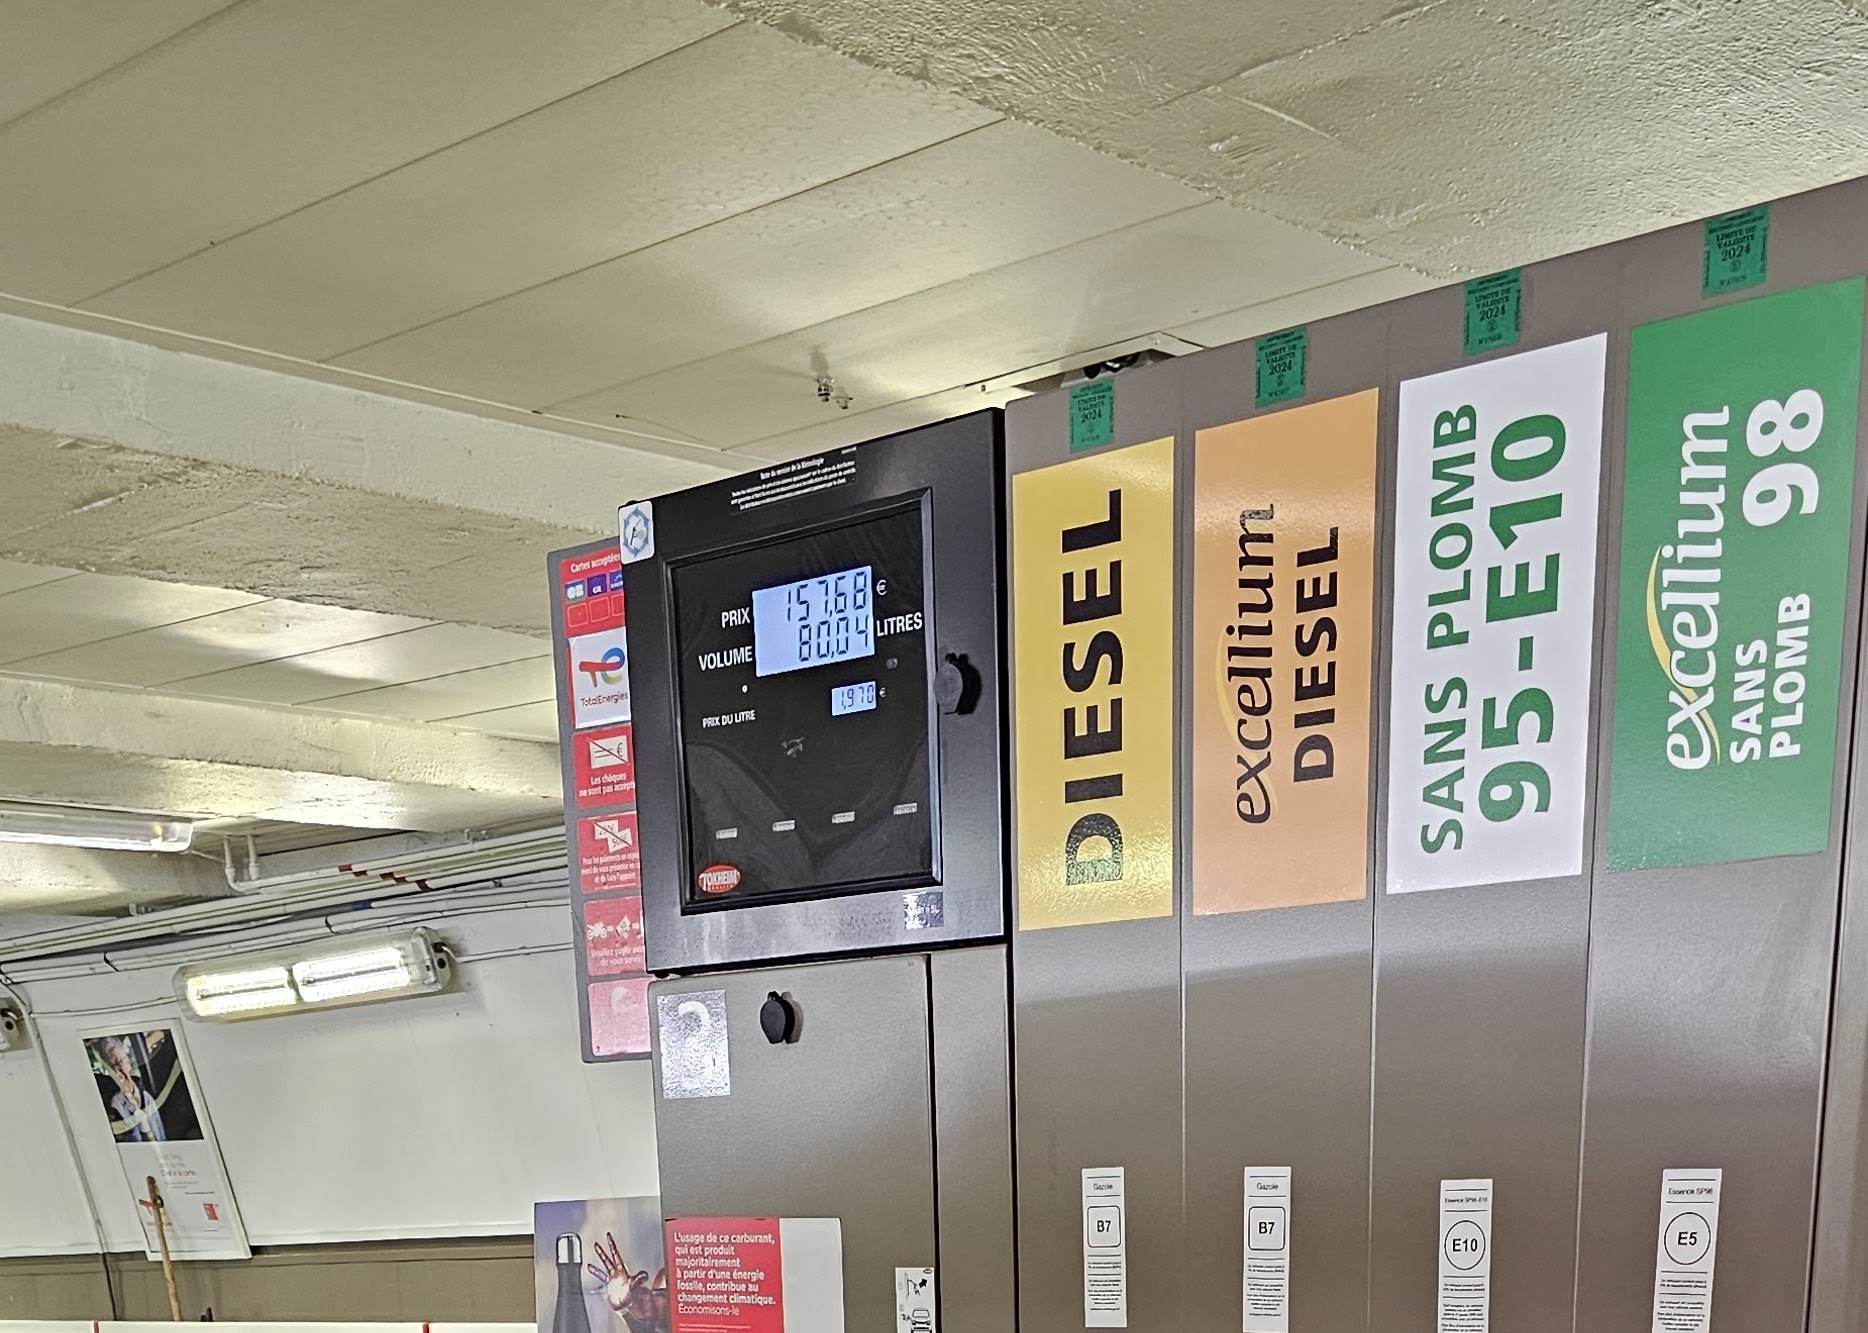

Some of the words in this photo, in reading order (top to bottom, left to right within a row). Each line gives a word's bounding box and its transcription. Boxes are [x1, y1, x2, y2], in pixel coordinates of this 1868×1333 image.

[1721, 242, 1750, 261] 2024
[1480, 304, 1505, 322] 2024
[1743, 389, 1823, 526] 98
[1428, 405, 1477, 648] PLOMB
[567, 584, 584, 599] CB
[787, 571, 867, 622] 157,68
[876, 579, 887, 596] €
[1661, 406, 1729, 770] excellium
[721, 607, 751, 629] PRIX
[1479, 415, 1566, 821] 95-E10
[799, 614, 869, 662] 80,04
[876, 612, 923, 637] LITRES
[698, 646, 753, 671] VOLUME
[1226, 503, 1274, 824] excellium
[1294, 527, 1339, 782] DIESEL
[1770, 594, 1811, 758] PLOMB
[841, 684, 875, 710] 1,970
[879, 687, 887, 698] €
[1062, 489, 1123, 886] DIESEL
[580, 691, 628, 707] TotalEnergies
[1730, 640, 1767, 763] SANS
[702, 716, 720, 729] PRIX
[721, 714, 734, 726] DU
[734, 709, 756, 723] LITRE
[1422, 677, 1468, 853] SANS
[699, 869, 738, 891] TOKHEIM
[1093, 1183, 1113, 1191] Gazole
[1256, 1183, 1279, 1191] Gazole
[1097, 1220, 1111, 1232] B7
[1259, 1222, 1275, 1234] B7
[674, 1232, 705, 1244] L'usage
[706, 1232, 718, 1243] de
[719, 1234, 730, 1243] ce
[731, 1233, 775, 1245] carburant,
[1452, 1238, 1478, 1252] E10
[1678, 1231, 1698, 1246] E5
[675, 1244, 688, 1256] qui
[690, 1245, 703, 1255] est
[704, 1244, 735, 1256] produit
[675, 1256, 740, 1268] majoritairement
[676, 1267, 682, 1278] à
[683, 1268, 706, 1280] partir
[707, 1269, 731, 1279] d'une
[732, 1269, 765, 1281] énergie
[677, 1279, 705, 1292] fossile,
[706, 1281, 746, 1292] contribue
[747, 1283, 759, 1292] au
[677, 1292, 727, 1303] changement
[729, 1293, 776, 1306] climatique.
[678, 1303, 740, 1315] Économisons-le
